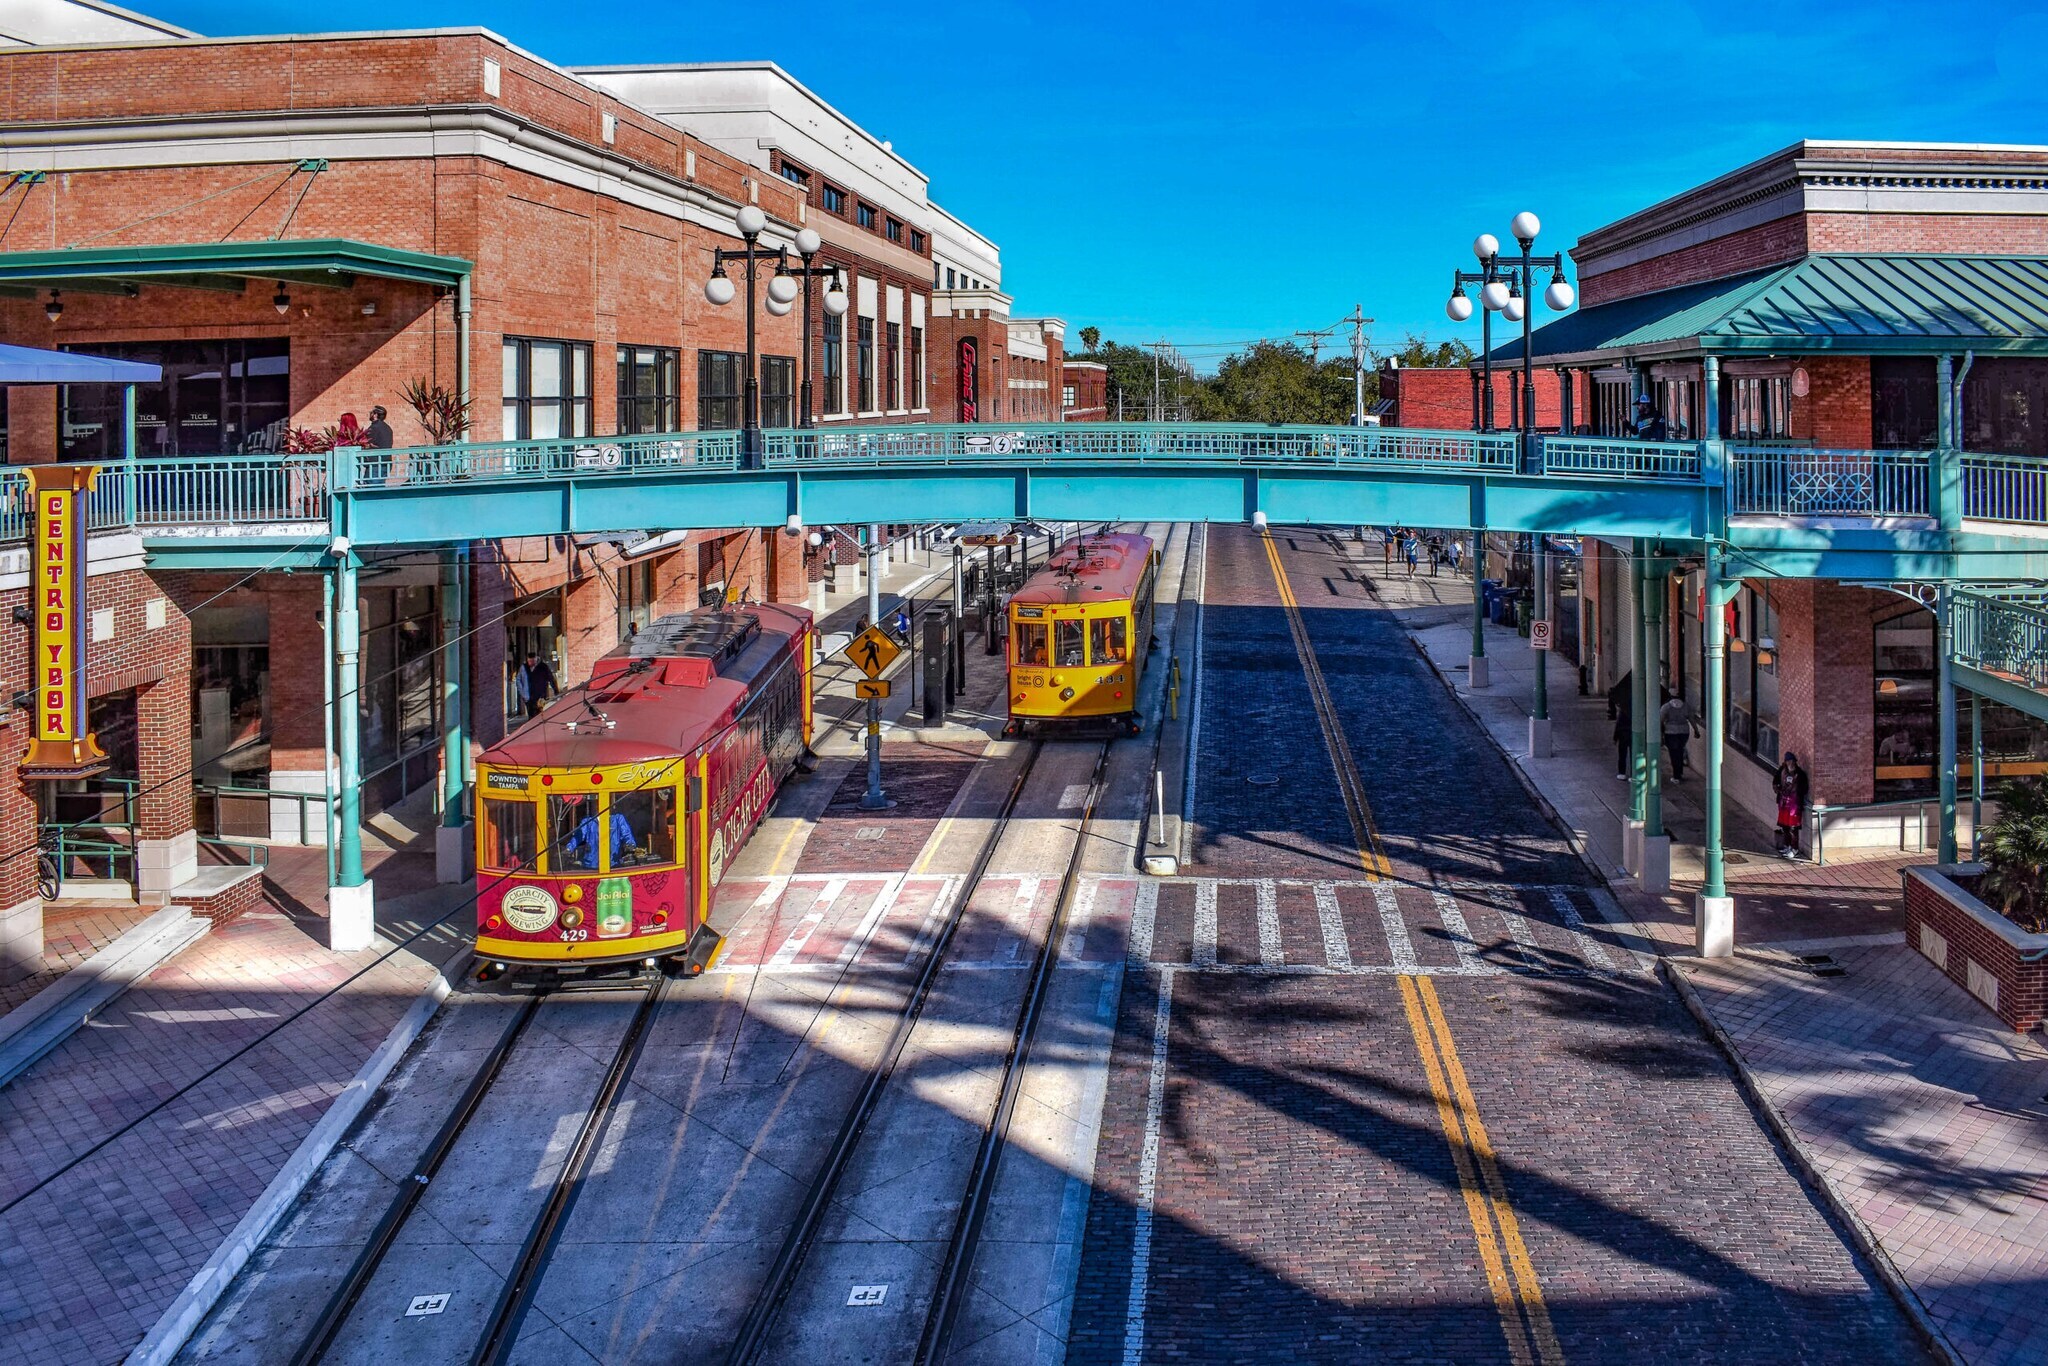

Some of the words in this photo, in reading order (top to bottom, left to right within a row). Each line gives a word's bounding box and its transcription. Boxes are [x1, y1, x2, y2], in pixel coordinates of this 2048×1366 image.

[46, 496, 65, 632] CENTRO
[46, 643, 65, 734] YBOR
[488, 774, 528, 784] DOWNTOWN
[498, 782, 519, 790] TAMPA
[724, 790, 752, 858] CIGAR
[753, 763, 770, 812] CITY
[509, 889, 532, 901] CIGAR
[532, 889, 549, 903] CITY
[597, 891, 611, 901] Jai
[612, 889, 630, 899] Alai
[509, 914, 548, 929] BREWING
[560, 929, 588, 942] 429
